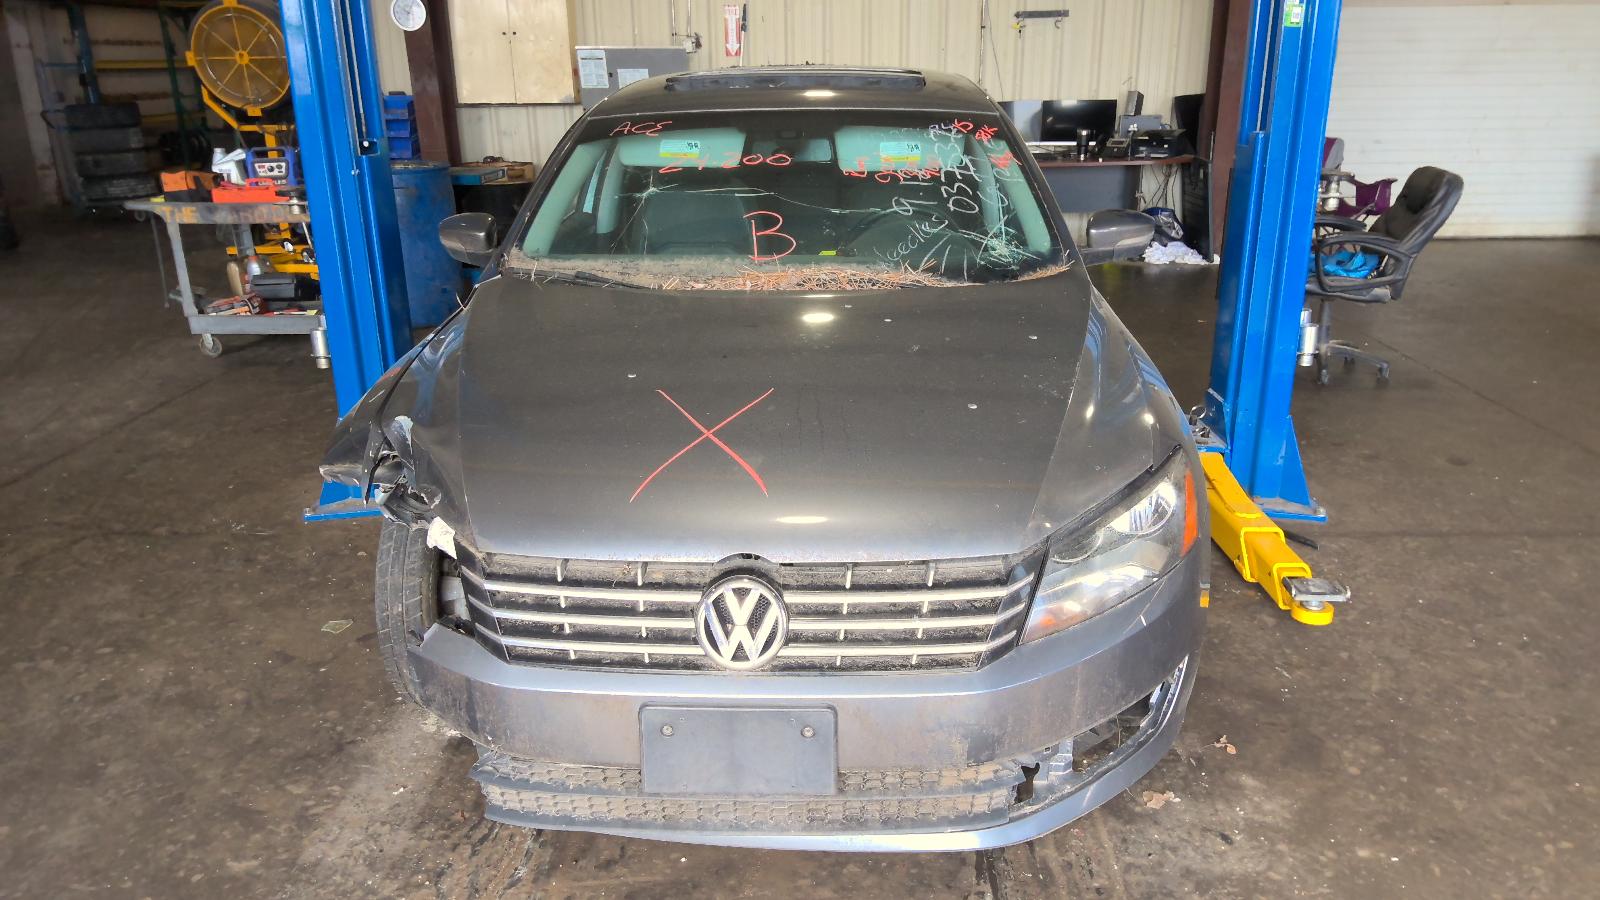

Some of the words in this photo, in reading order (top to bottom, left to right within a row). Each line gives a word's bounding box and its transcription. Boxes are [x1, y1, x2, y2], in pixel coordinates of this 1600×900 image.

[609, 121, 673, 137] ACE
[743, 210, 797, 264] B
[698, 578, 784, 667] VW
